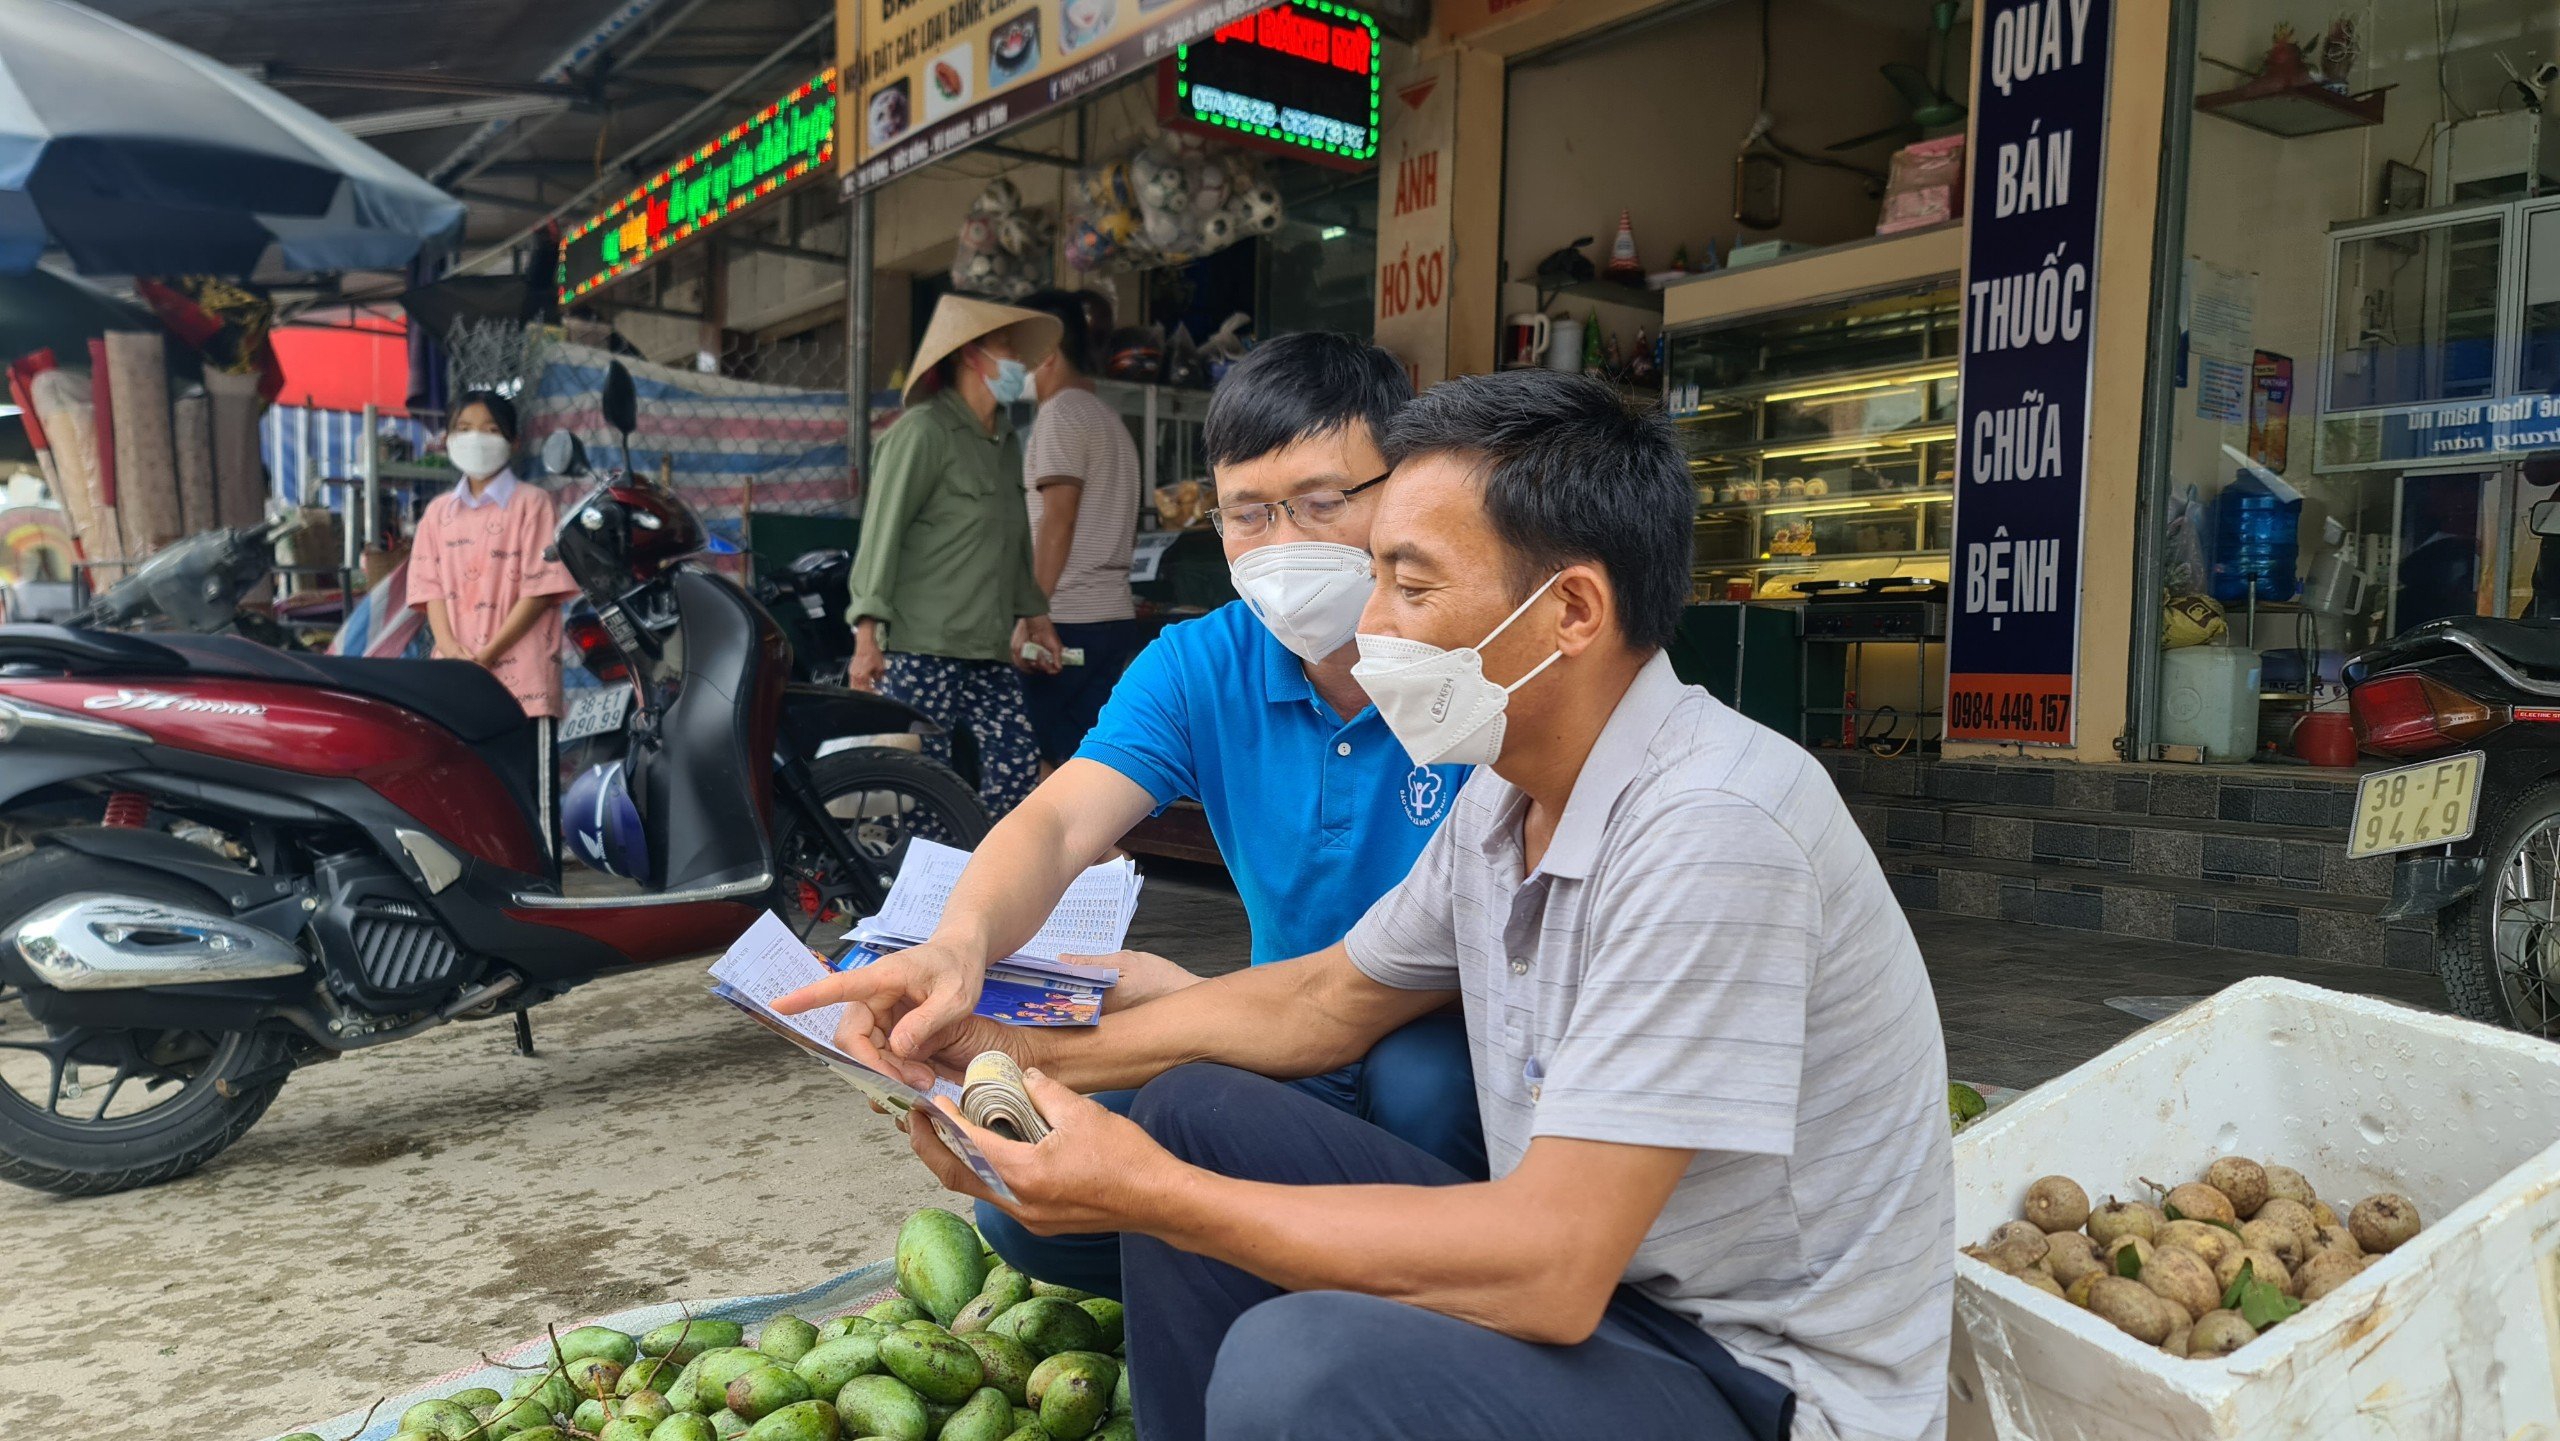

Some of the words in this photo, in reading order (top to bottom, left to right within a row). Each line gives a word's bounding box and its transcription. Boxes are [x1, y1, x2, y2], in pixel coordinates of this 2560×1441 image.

[1394, 140, 1439, 218] ẢNH
[1996, 118, 2073, 219] BÁN
[1381, 240, 1411, 320] HỒ
[1415, 246, 1444, 312] SƠ
[1970, 241, 2086, 354] THUỐC
[1972, 389, 2062, 485] CHỮA
[1966, 526, 2061, 631] BỆNH
[566, 710, 621, 738] 090.99
[1952, 692, 2071, 733] 0984.449.157
[2364, 800, 2460, 850] 9449
